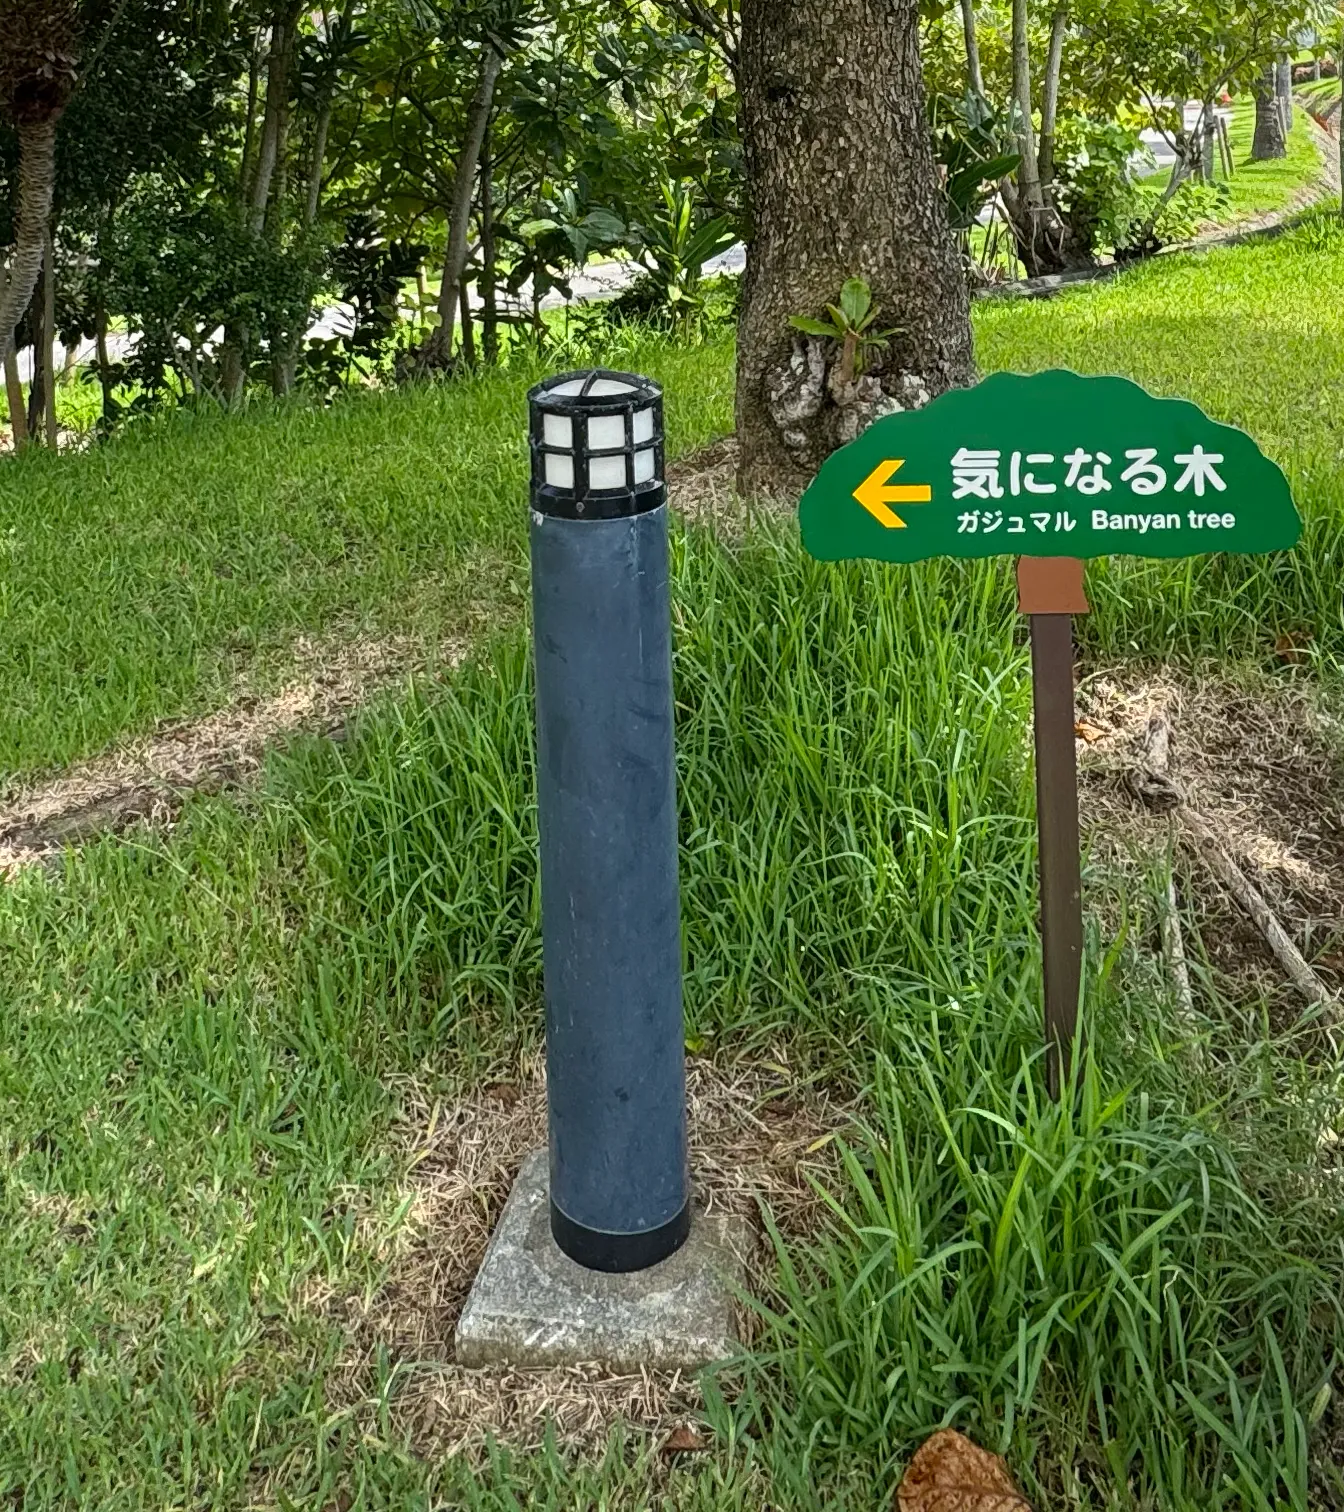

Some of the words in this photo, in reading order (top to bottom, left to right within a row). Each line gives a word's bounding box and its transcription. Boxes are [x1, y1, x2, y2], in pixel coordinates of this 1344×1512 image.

[951, 445, 1227, 500] 気になる木
[957, 510, 1077, 534] ガジュマル
[1091, 510, 1181, 534] Banyan
[1188, 510, 1236, 529] tree
